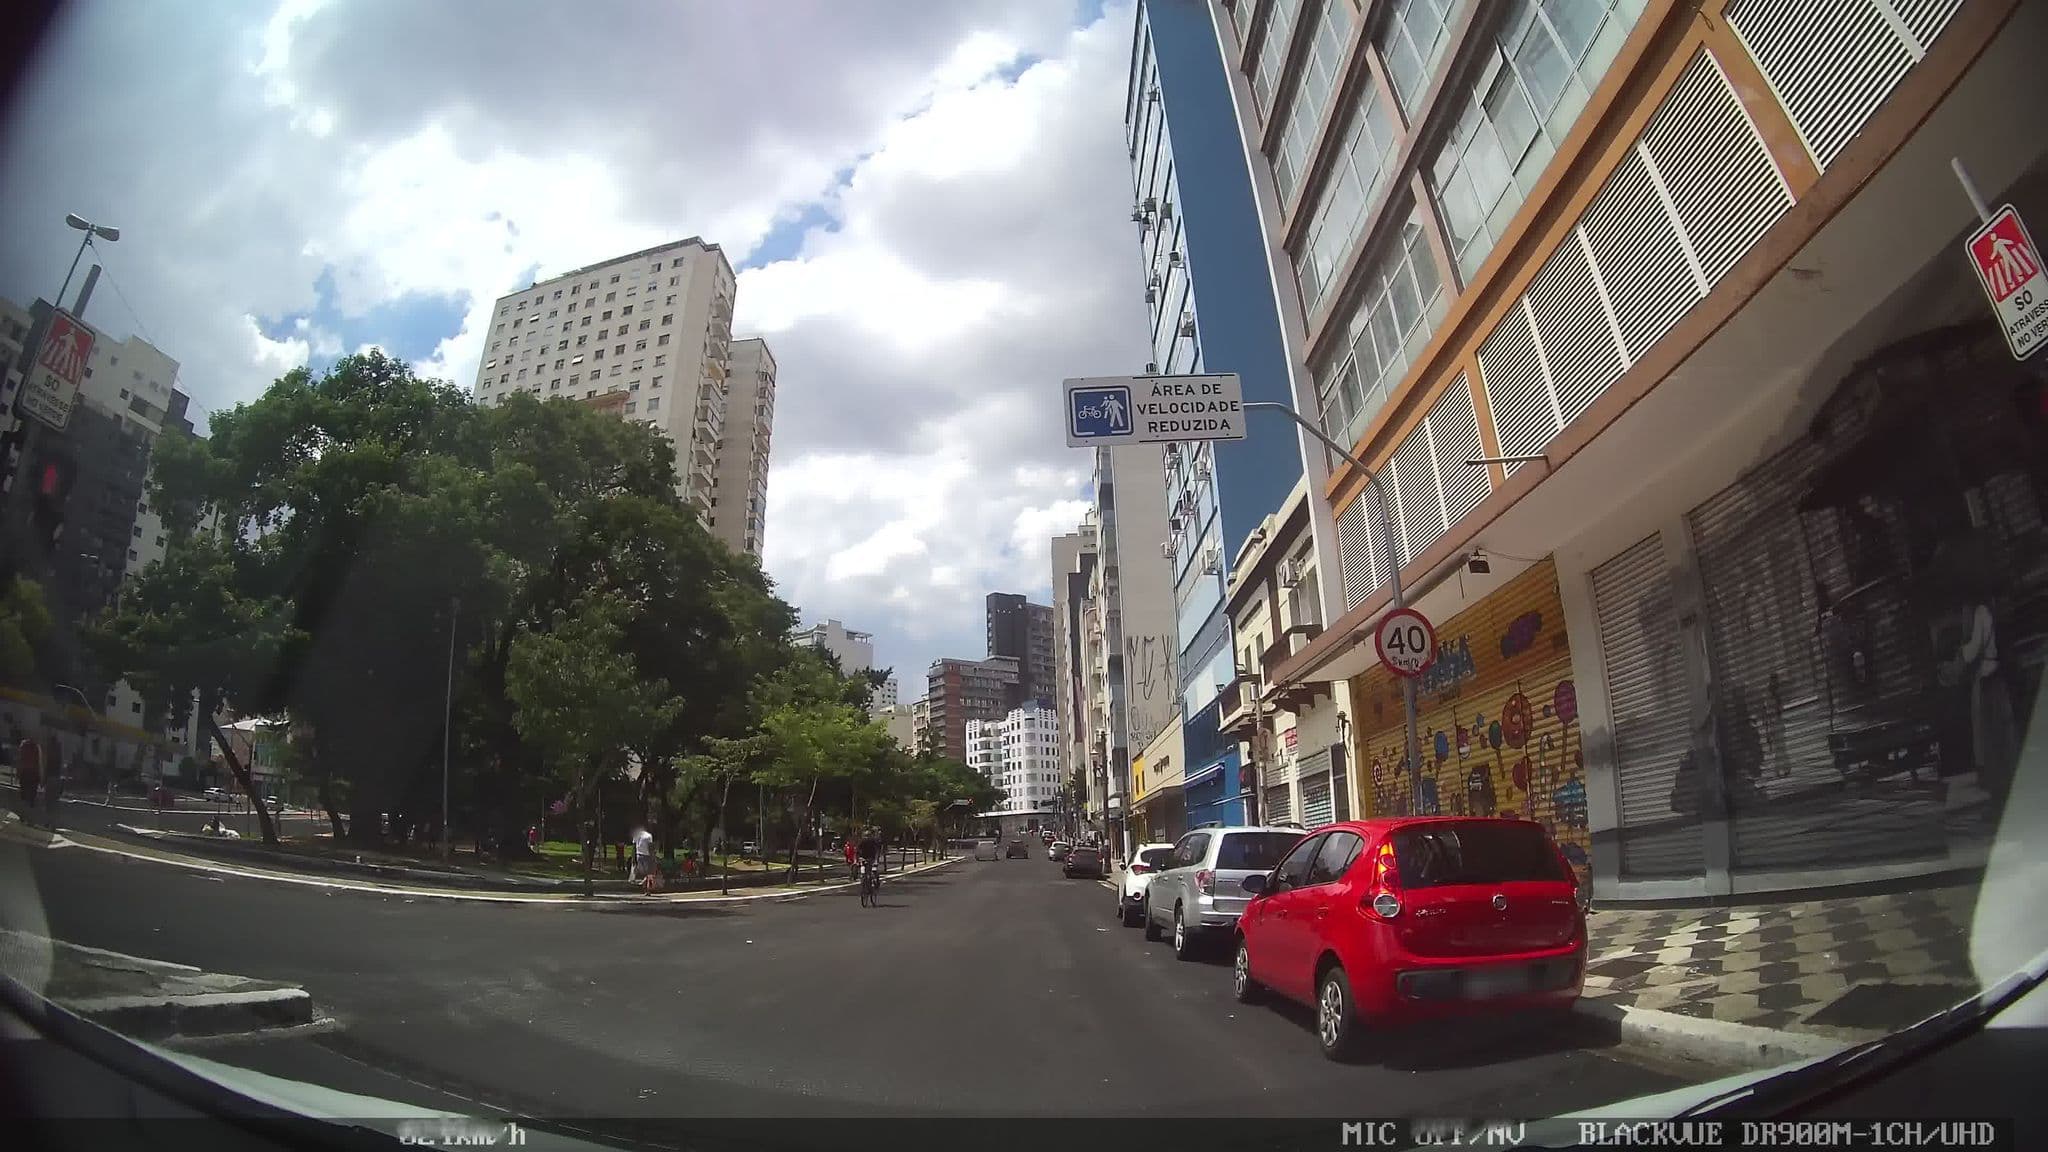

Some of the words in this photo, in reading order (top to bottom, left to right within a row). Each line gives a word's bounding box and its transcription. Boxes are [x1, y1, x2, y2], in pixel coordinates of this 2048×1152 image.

[2014, 286, 2034, 311] SÓ
[2017, 332, 2031, 349] NO
[2030, 316, 2048, 338] VER
[1151, 382, 1196, 397] ÁREA
[1201, 383, 1222, 395] DE
[1136, 400, 1241, 416] VELOCIDADE
[1147, 418, 1232, 433] REDUZIDA
[1387, 625, 1426, 655] 40
